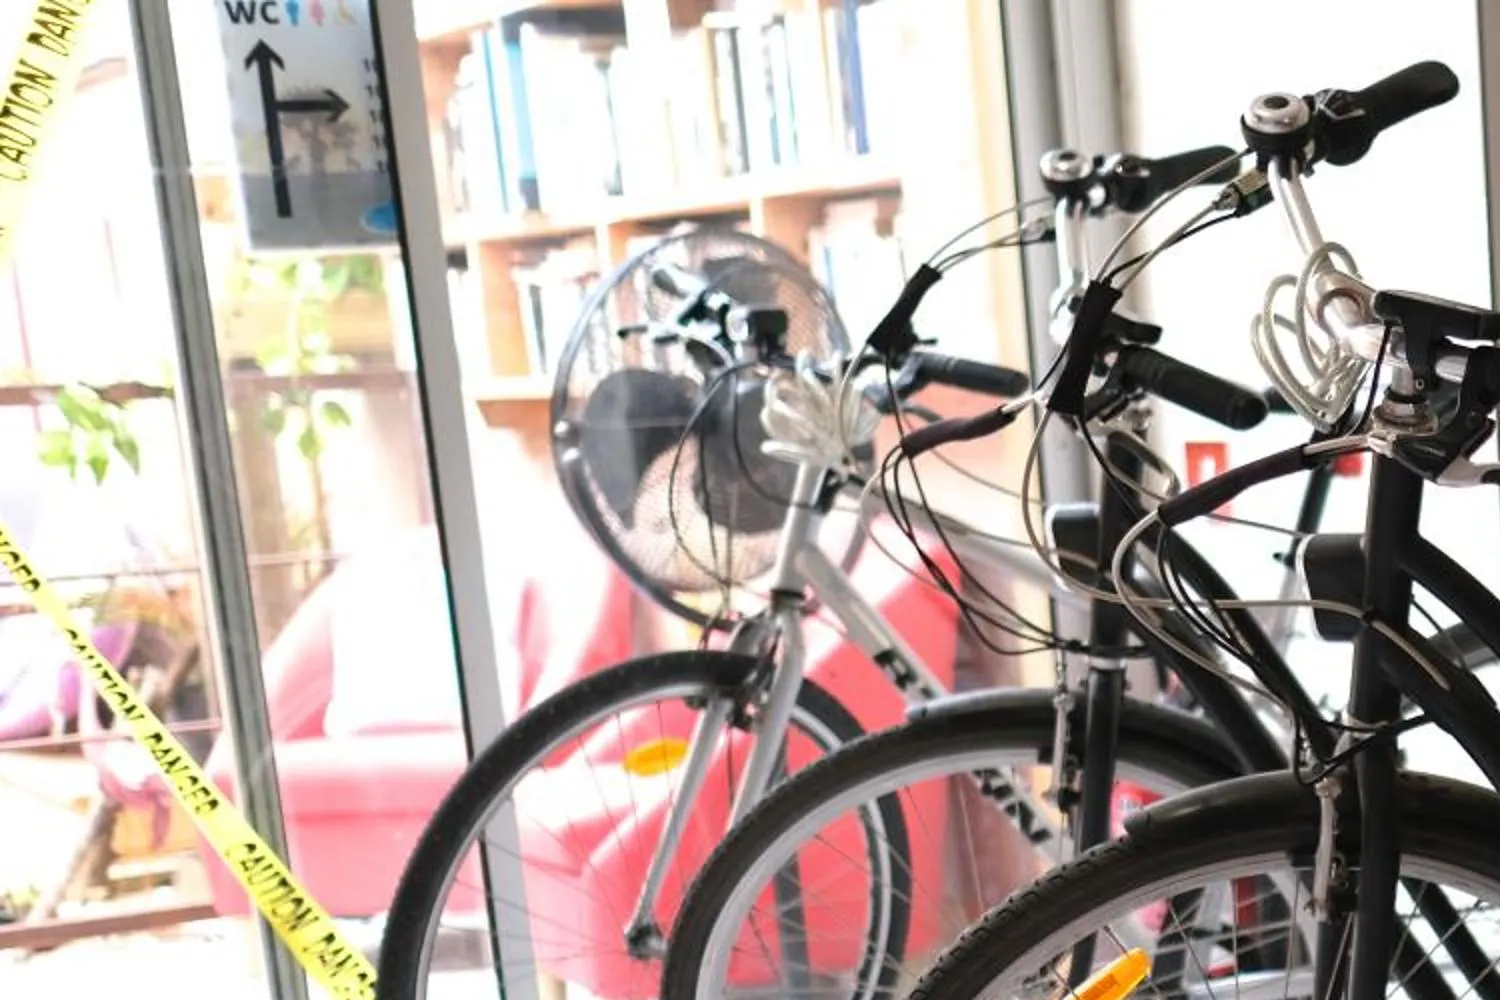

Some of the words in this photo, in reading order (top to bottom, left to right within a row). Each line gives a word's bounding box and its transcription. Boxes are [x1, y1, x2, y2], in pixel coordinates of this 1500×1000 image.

[26, 0, 90, 56] DAN
[224, 0, 280, 24] WC
[224, 843, 320, 932] CAUTION
